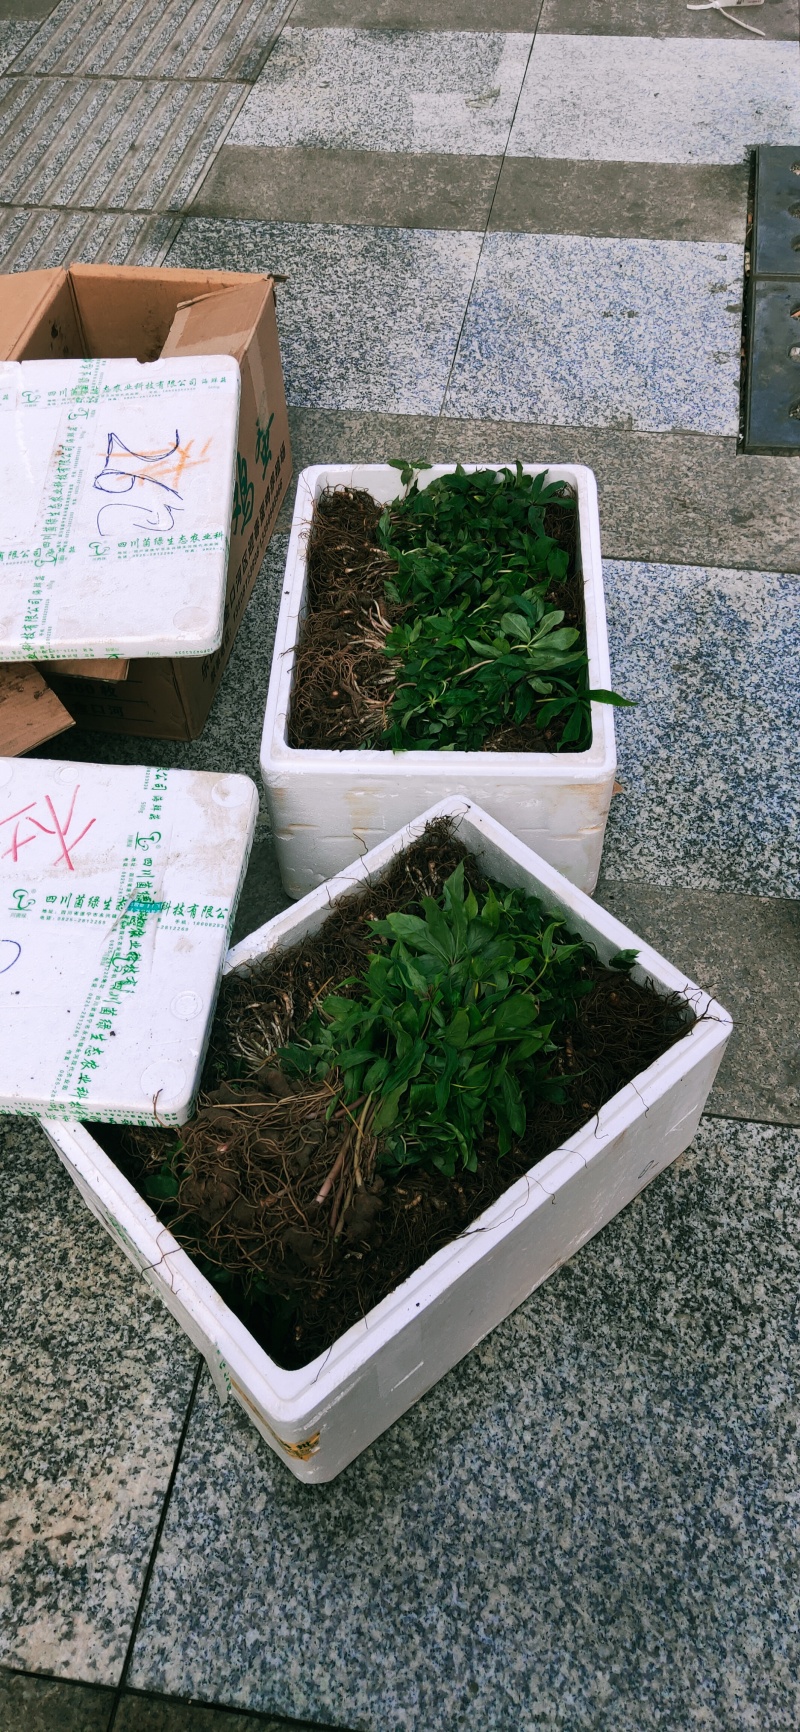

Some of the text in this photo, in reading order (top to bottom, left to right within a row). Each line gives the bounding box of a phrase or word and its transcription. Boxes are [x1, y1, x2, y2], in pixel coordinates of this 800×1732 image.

[117, 531, 223, 549] 四川菌绿生态农业科
